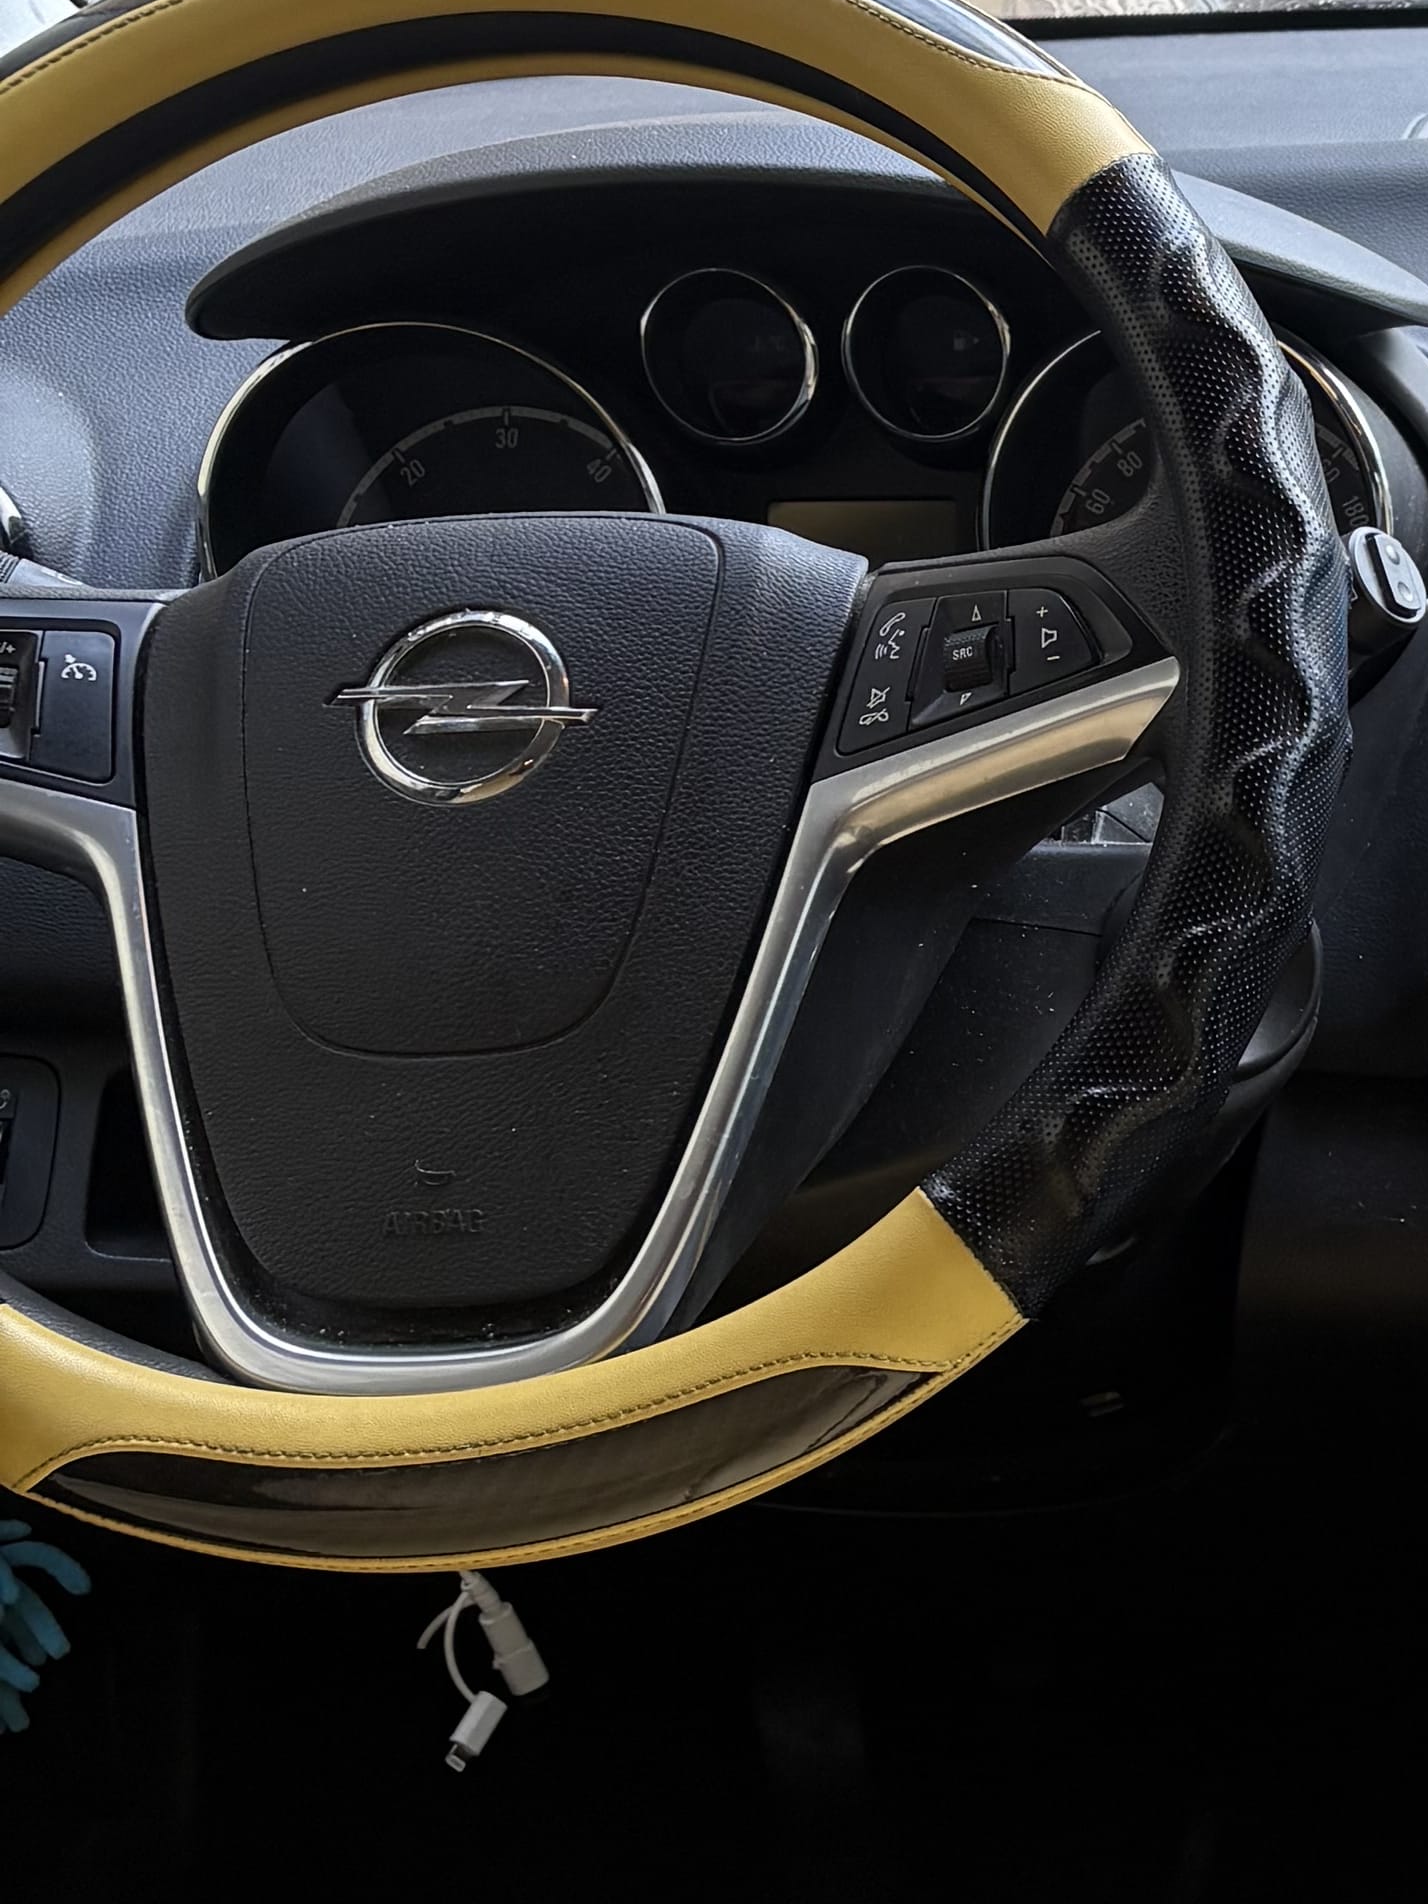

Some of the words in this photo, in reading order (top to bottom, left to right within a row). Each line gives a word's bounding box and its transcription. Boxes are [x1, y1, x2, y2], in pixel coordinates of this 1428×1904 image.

[495, 428, 519, 449] 30
[400, 459, 426, 487] 20
[587, 458, 612, 484] 40
[1117, 451, 1143, 477] 80
[1086, 488, 1111, 514] 60
[952, 646, 973, 661] SRC
[383, 1207, 488, 1235] AIRBAG
